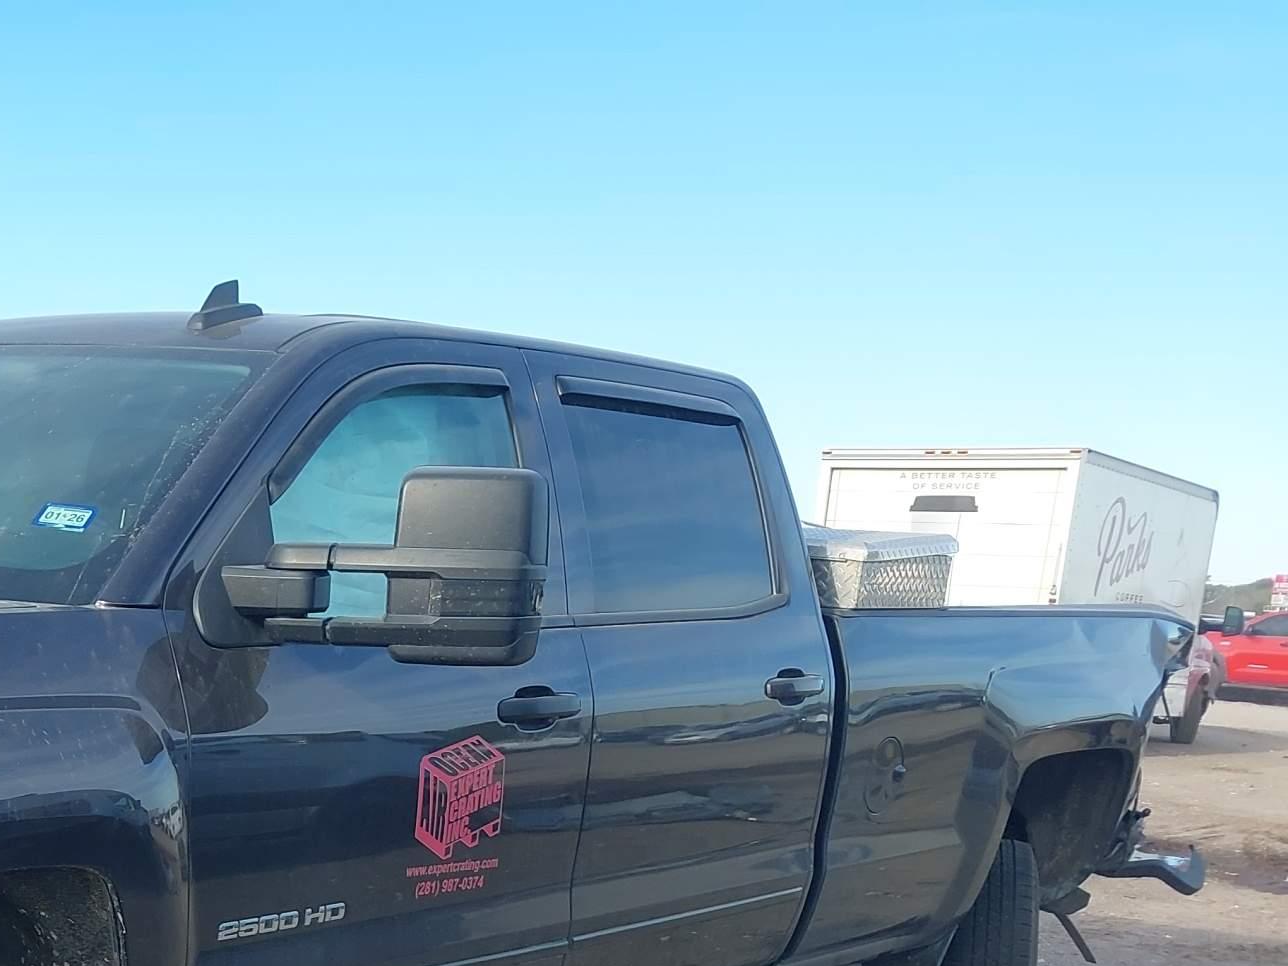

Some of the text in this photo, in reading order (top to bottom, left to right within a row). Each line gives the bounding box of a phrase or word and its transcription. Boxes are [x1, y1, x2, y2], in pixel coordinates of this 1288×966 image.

[913, 482, 981, 490] OF SERVICE
[1093, 495, 1154, 597] Parks
[428, 740, 497, 776] OCEAN
[450, 765, 495, 801] EXPERT
[419, 768, 448, 843] AIR
[449, 782, 502, 822] CRATING
[447, 816, 471, 844] INC.
[407, 859, 499, 877] www.expertcrating.com
[415, 875, 484, 899] (281) 987-0374
[217, 902, 346, 941] 2500 HD
